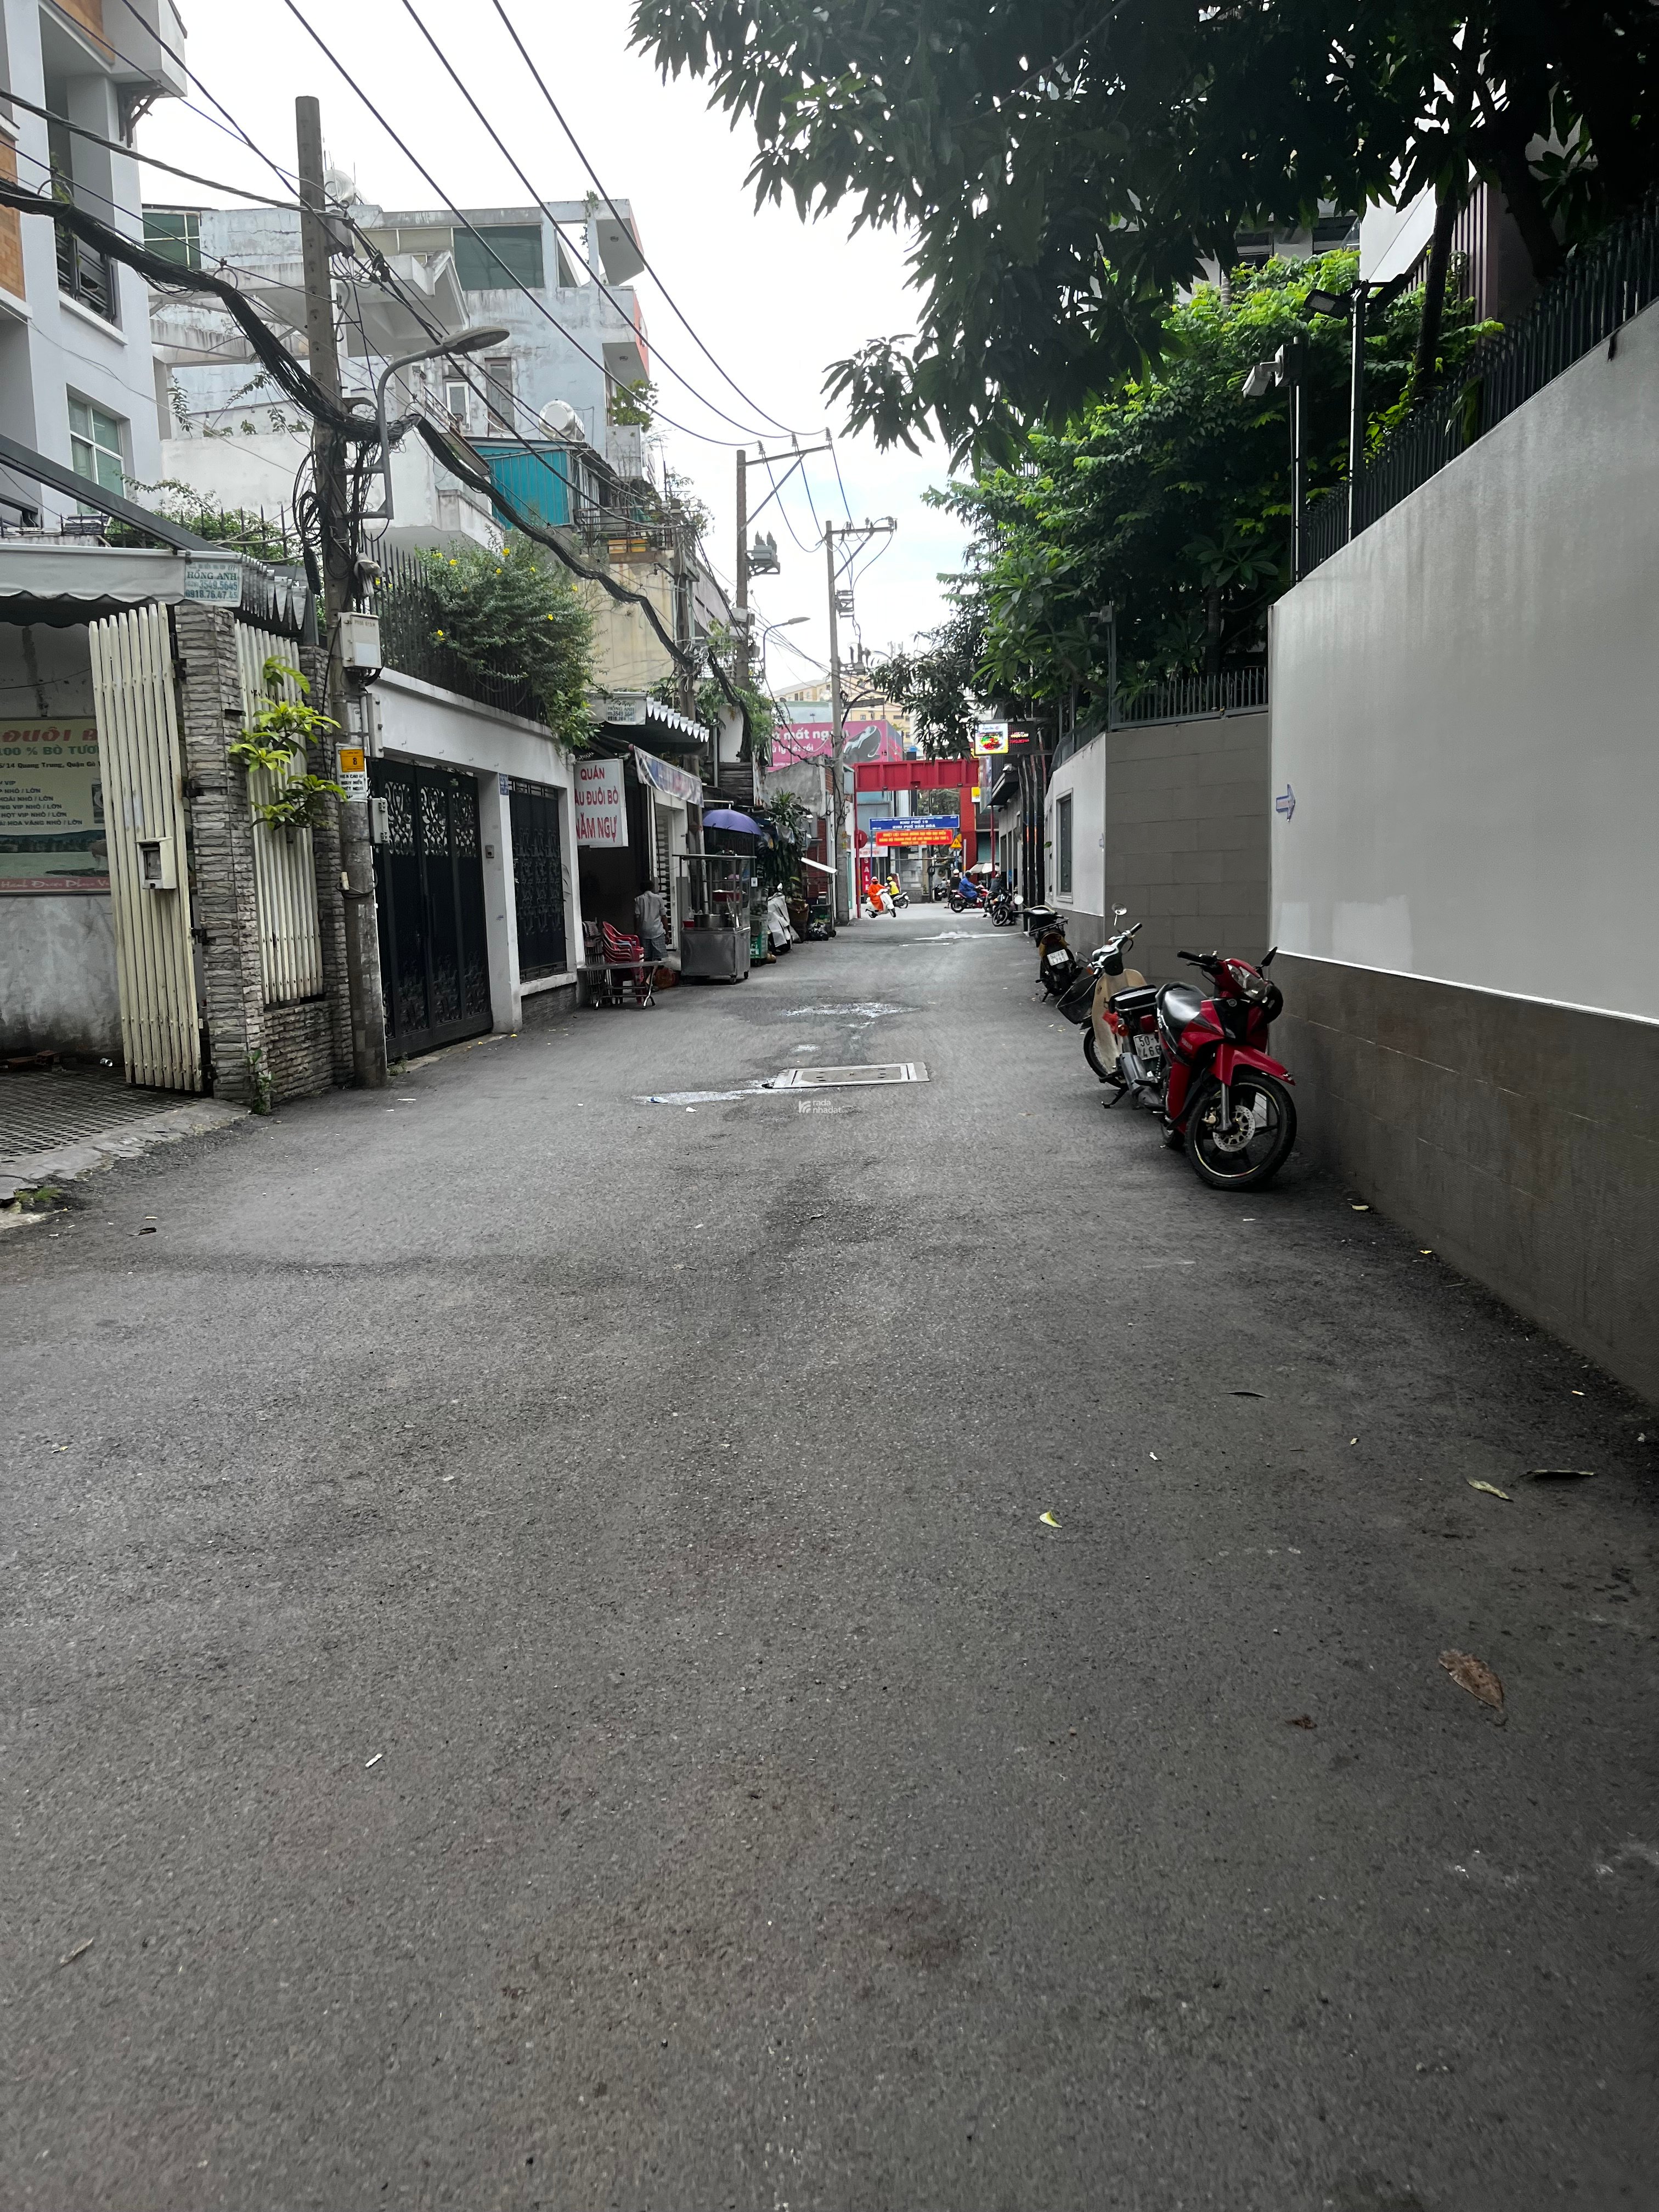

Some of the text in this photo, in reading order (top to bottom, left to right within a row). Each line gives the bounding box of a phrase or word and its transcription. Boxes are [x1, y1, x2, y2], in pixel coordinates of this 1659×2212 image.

[187, 569, 213, 579] HỒNG
[2, 726, 98, 743] ĐUÔI B
[783, 727, 810, 740] mất
[43, 744, 63, 755] BÒ
[580, 765, 605, 781] QUÁN
[586, 786, 606, 805] ĐUÔI
[607, 785, 619, 805] BÒ
